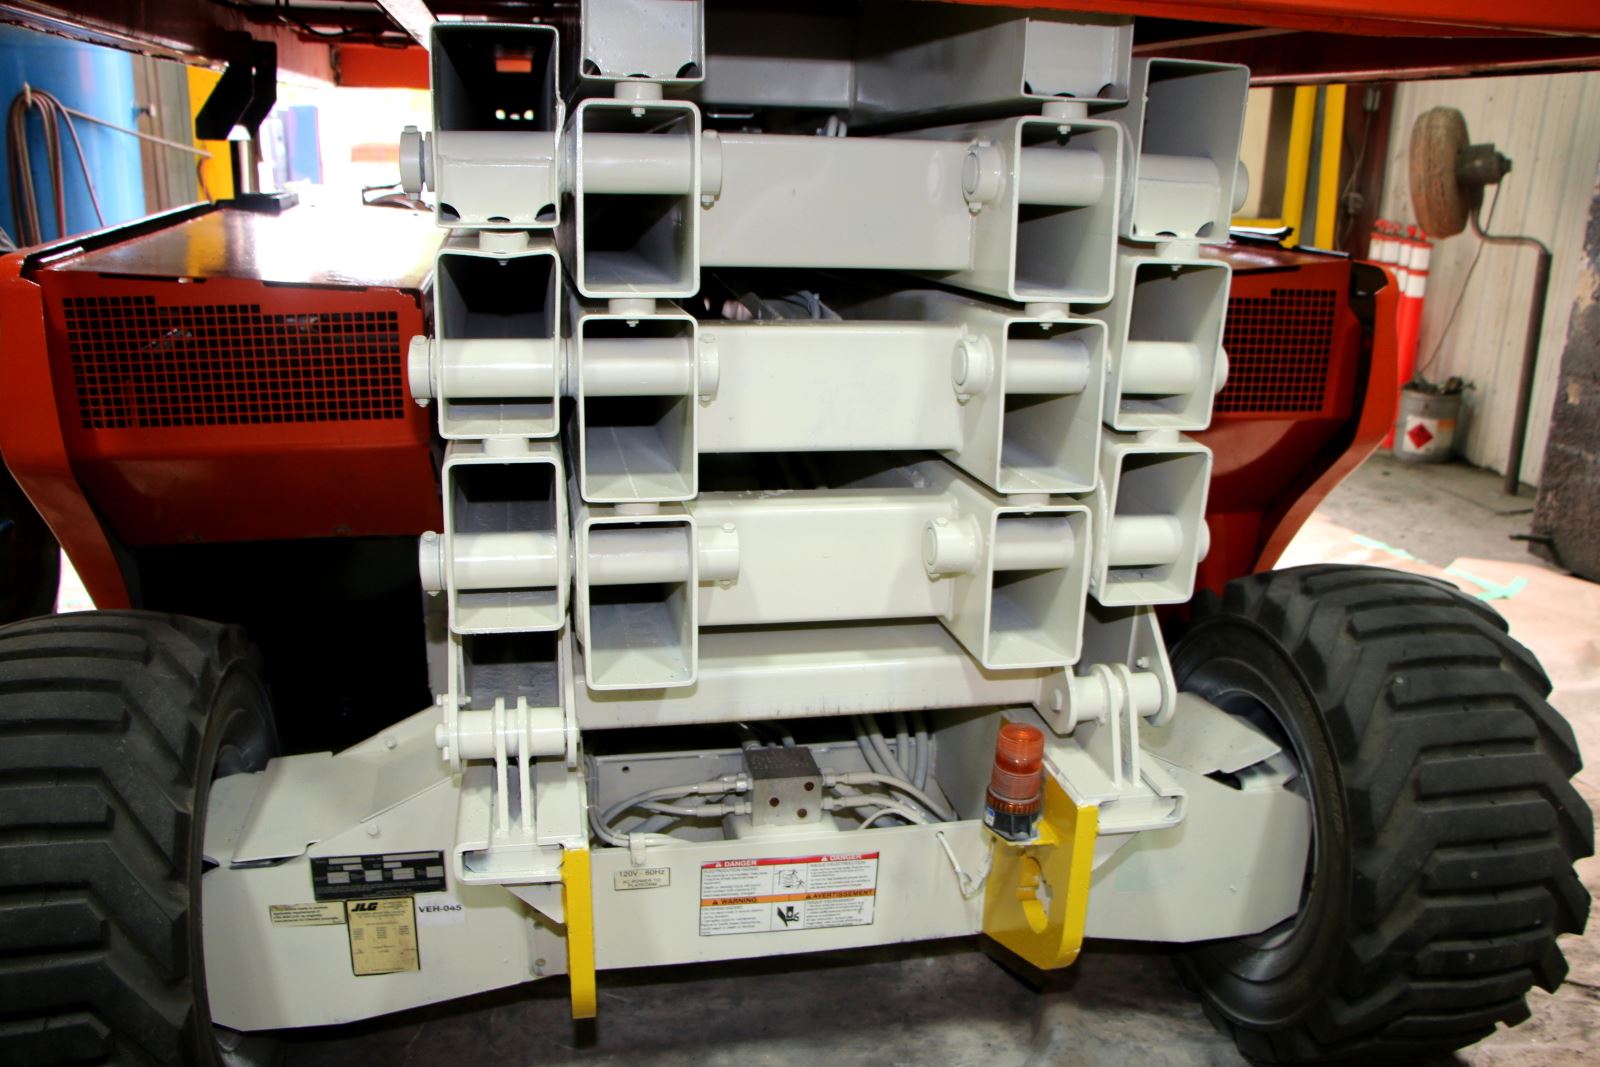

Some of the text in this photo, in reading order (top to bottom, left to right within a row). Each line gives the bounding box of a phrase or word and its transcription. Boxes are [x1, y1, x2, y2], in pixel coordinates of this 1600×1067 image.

[813, 889, 872, 899] AVERTISSEMENT
[720, 897, 758, 905] WARNING
[351, 902, 378, 912] JLG
[419, 904, 462, 913] VEH-045
